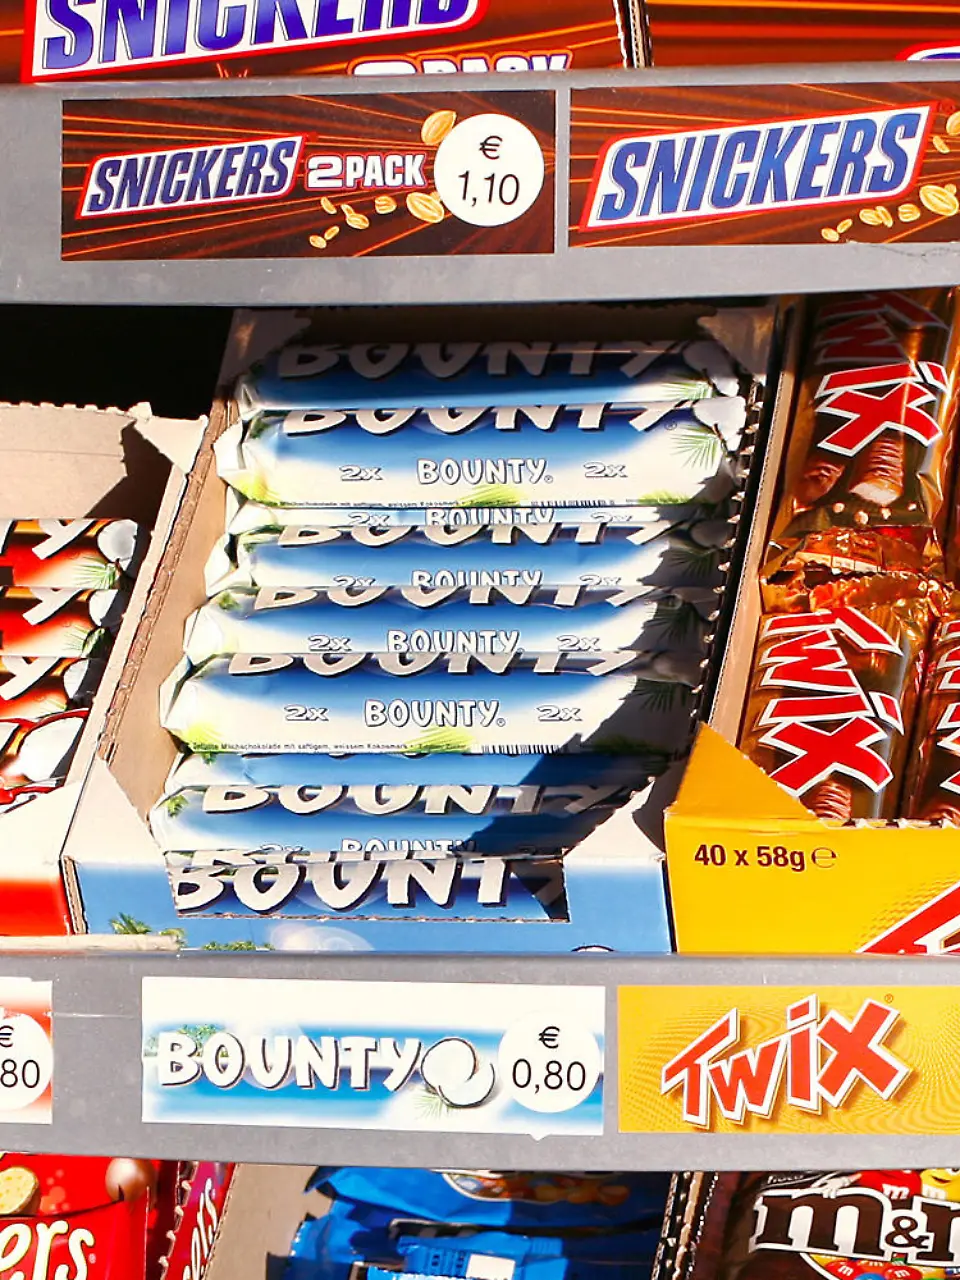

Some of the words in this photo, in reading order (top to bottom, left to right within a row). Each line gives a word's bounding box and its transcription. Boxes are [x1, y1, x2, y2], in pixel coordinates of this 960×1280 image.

[479, 135, 502, 162] €
[88, 140, 294, 213] SNICKERS
[598, 112, 923, 222] SNICKERS
[457, 171, 520, 206] 1,10
[416, 458, 547, 485] BOUNTY
[386, 630, 521, 653] BOUNTY
[365, 699, 502, 727] BOUNTY
[694, 843, 727, 867] 40
[734, 849, 750, 867] x
[756, 844, 806, 872] 58g
[538, 1025, 561, 1049] €
[158, 1031, 424, 1092] BOUNTY
[511, 1058, 587, 1094] 0,80
